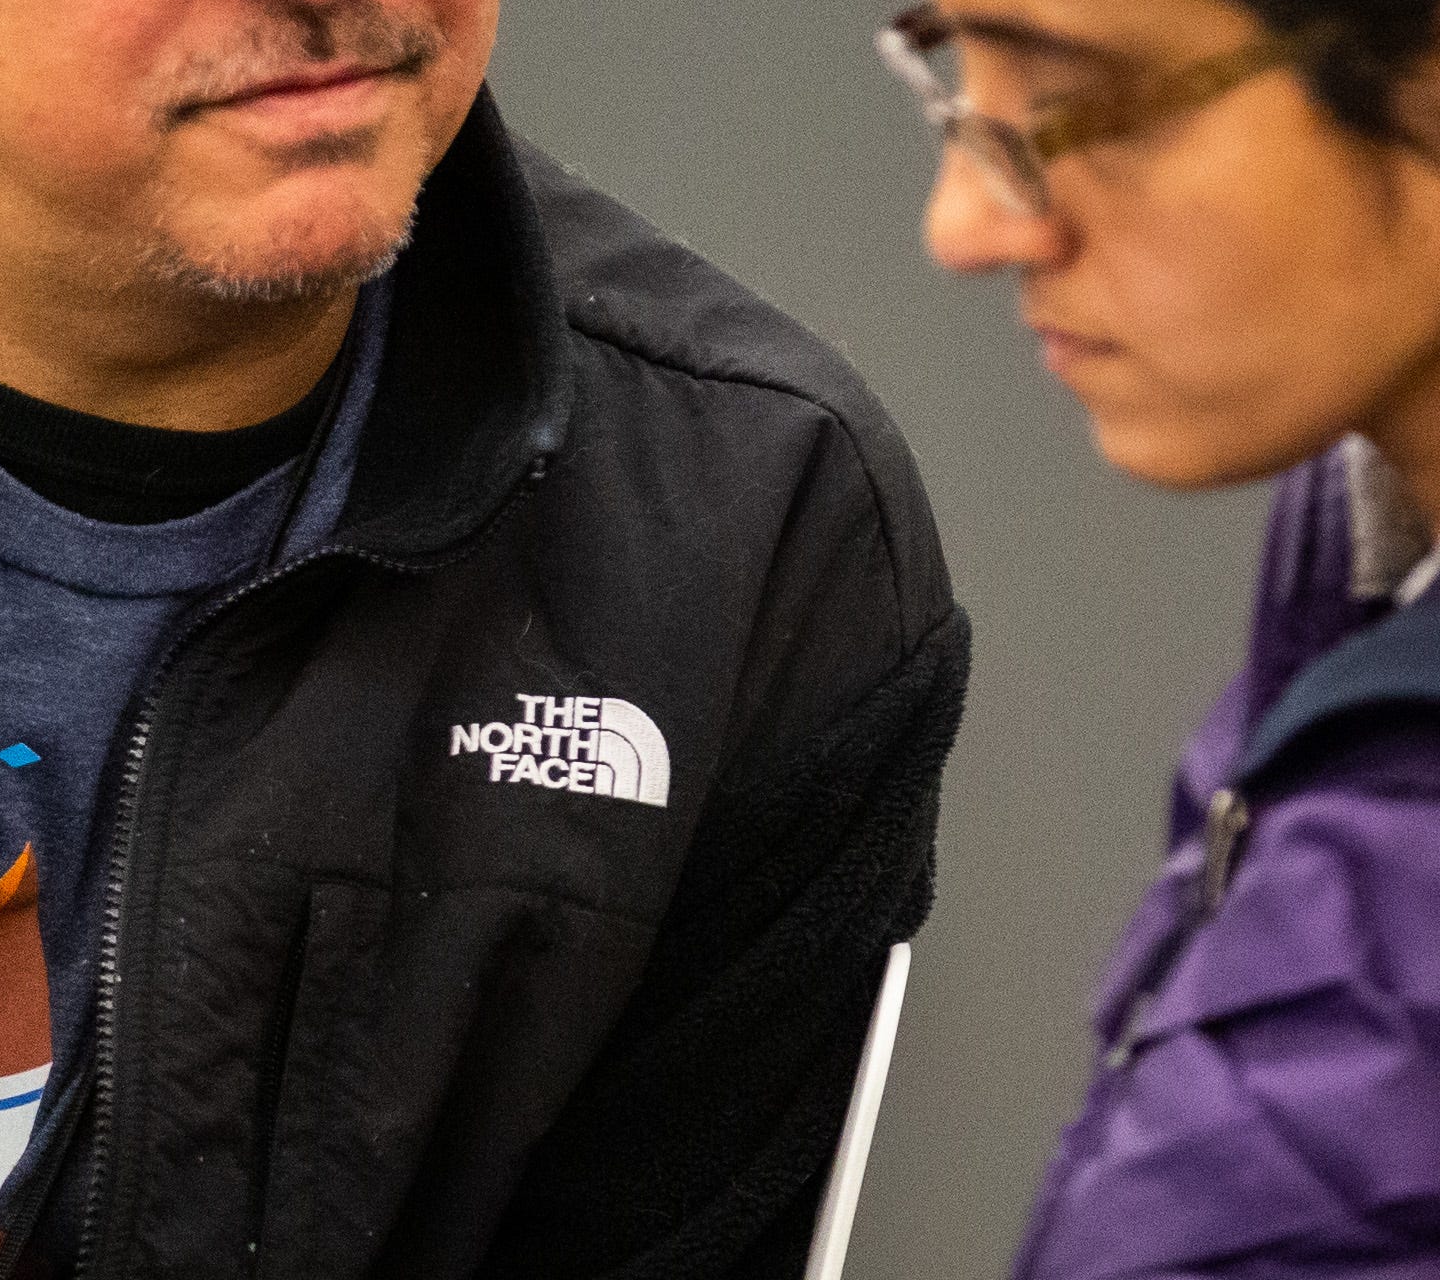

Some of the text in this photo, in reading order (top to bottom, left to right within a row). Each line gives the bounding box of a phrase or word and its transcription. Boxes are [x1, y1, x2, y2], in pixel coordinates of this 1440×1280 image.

[516, 693, 601, 729] THE
[449, 722, 599, 762] NORTH
[489, 753, 596, 794] FACE
